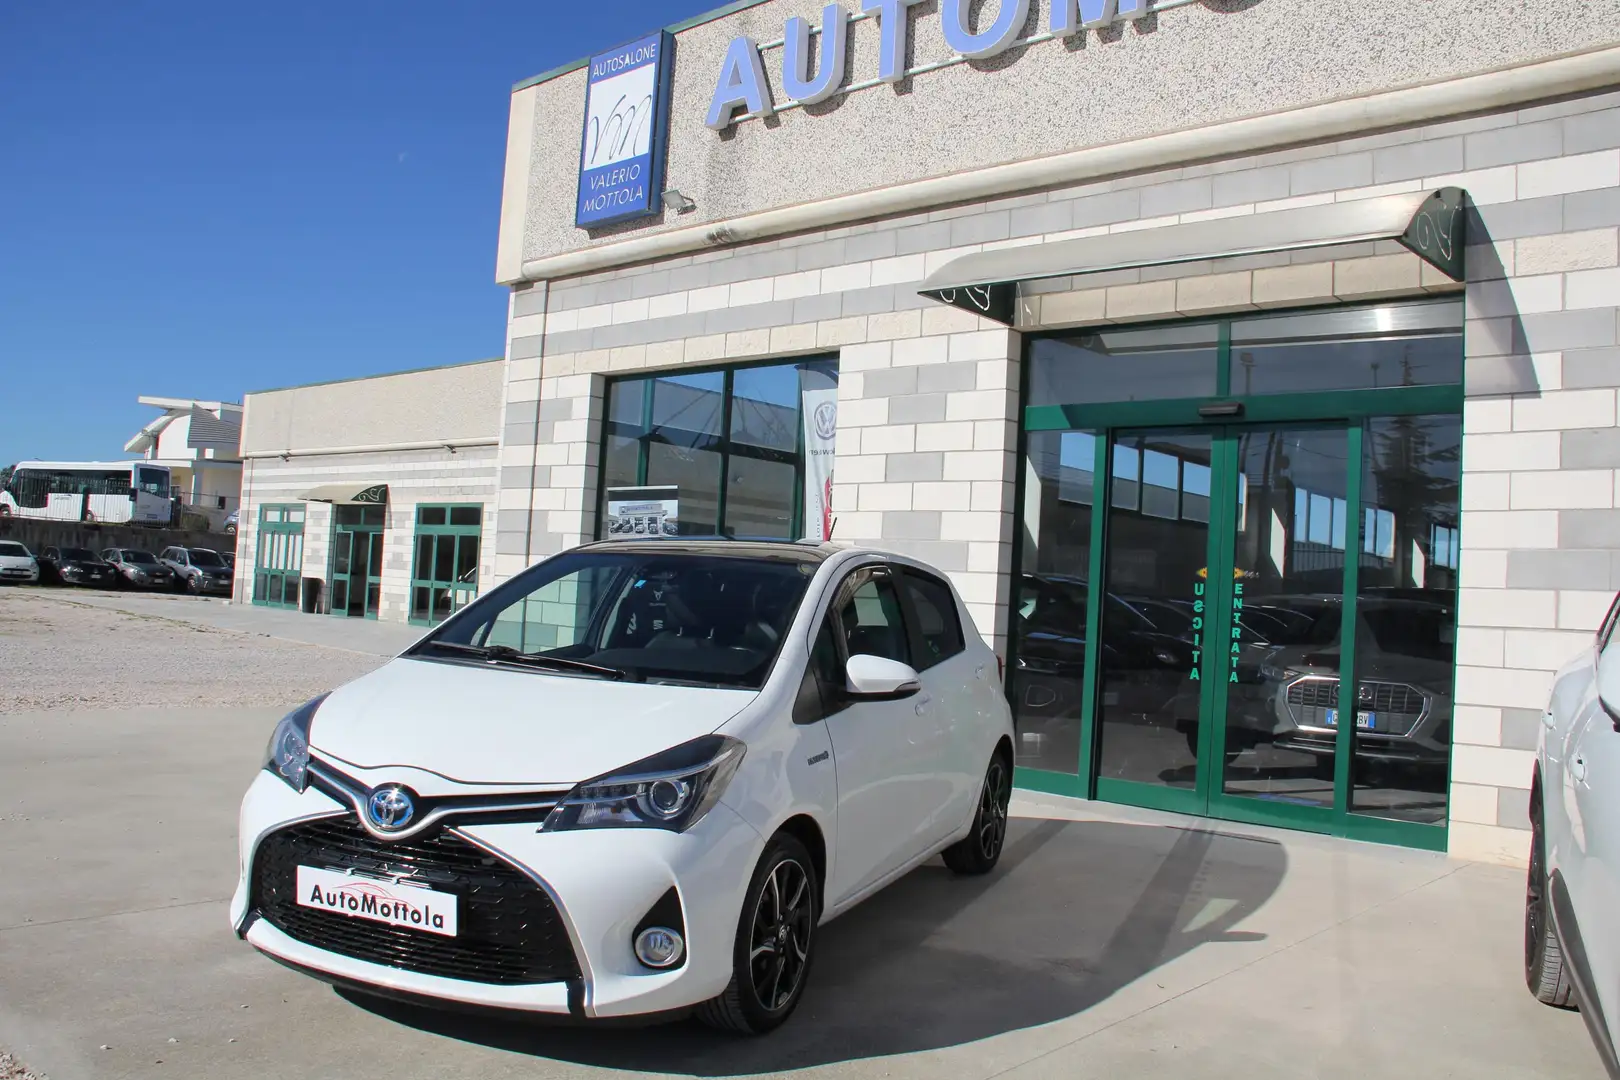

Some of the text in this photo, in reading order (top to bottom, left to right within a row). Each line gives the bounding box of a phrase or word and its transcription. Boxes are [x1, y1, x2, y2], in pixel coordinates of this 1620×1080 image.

[592, 44, 656, 78] AUTOSALONE
[590, 164, 641, 190] VALERIO
[583, 185, 643, 213] MOTTOLA
[1229, 583, 1243, 682] ENTRATA
[310, 884, 444, 929] AutoMottola
